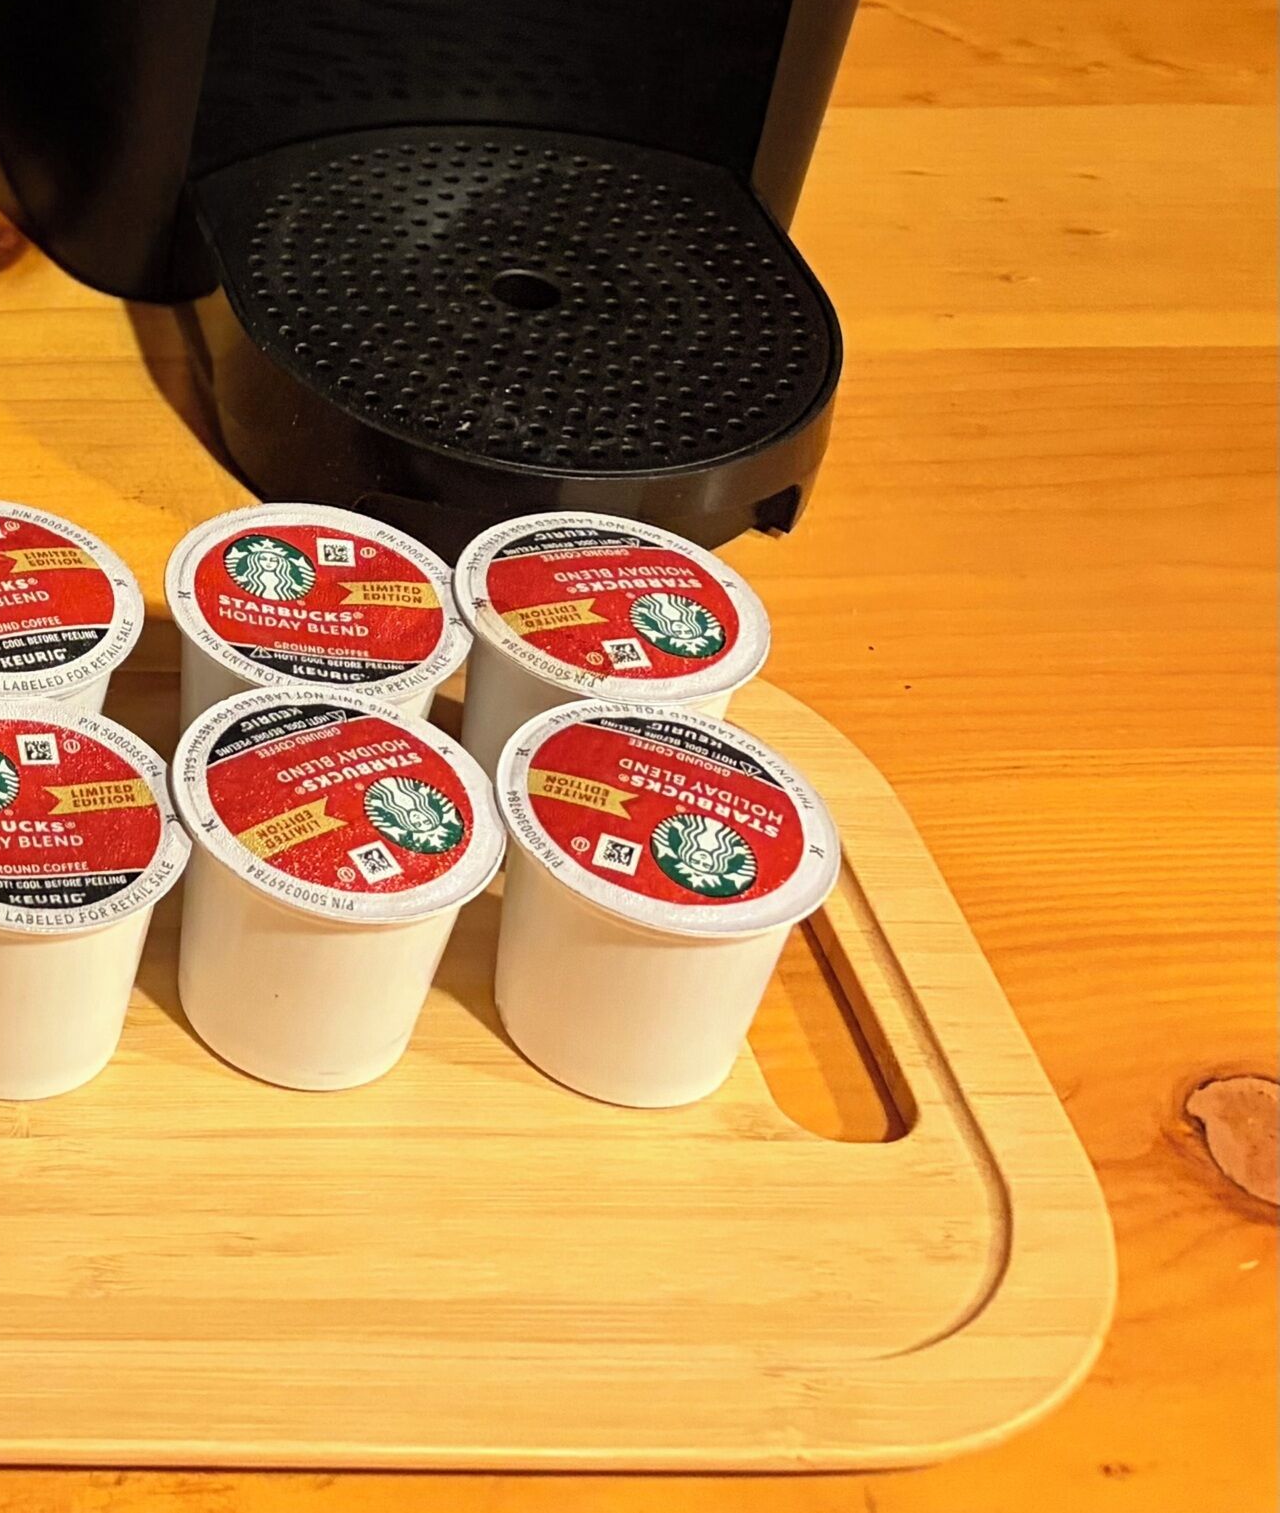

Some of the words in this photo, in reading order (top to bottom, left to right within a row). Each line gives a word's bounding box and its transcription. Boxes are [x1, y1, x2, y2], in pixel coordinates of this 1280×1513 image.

[24, 550, 78, 560] LIMITED
[29, 557, 82, 567] EDITION
[554, 571, 613, 581] BLEND
[617, 568, 695, 577] HOLIDAY
[363, 584, 421, 595] LIMITED
[363, 593, 423, 604] EDITION
[521, 604, 577, 620] EDITION
[526, 612, 580, 627] LIMITED
[21, 616, 62, 628] COFFEE
[219, 608, 300, 630] HOLIDAY
[308, 621, 369, 637] BLEND
[26, 633, 60, 645] BEFORE
[62, 630, 98, 640] PEELING
[1, 648, 67, 669] KEURIG
[3, 675, 64, 691] LABELED
[66, 665, 92, 682] FOR
[91, 643, 123, 670] RETAIL
[118, 618, 134, 649] SALE
[274, 642, 323, 656] GROUND
[197, 628, 220, 651] THIS
[222, 651, 249, 673] UNIT
[254, 668, 283, 685] NOT
[386, 673, 424, 694] RETAIL
[427, 654, 450, 676] SALE
[293, 666, 363, 680] KEURIG
[232, 692, 292, 712] LABELED
[299, 692, 323, 700] NOT
[209, 710, 228, 727] FOR
[241, 708, 303, 732] KEURIG
[369, 704, 400, 721] THIS
[294, 728, 341, 748] GROUND
[650, 722, 722, 748] KEURIG
[217, 737, 257, 757] PEELING
[256, 743, 291, 759] COFFEE
[339, 739, 411, 764] HOLIDAY
[628, 737, 674, 756] COFFEE
[737, 740, 765, 761] NOT
[184, 754, 198, 782] SALE
[278, 759, 334, 783] BLEND
[619, 758, 686, 786] BLEND
[677, 750, 731, 777] GROUND
[761, 755, 794, 783] UNIT
[71, 784, 133, 798] LIMITED
[543, 783, 606, 808] LIMITED
[545, 775, 610, 797] EDITION
[72, 794, 135, 808] EDITION
[692, 781, 784, 824] HOLIDAY
[792, 786, 814, 811] THIS
[256, 809, 314, 840] EDITION
[265, 818, 321, 850] LIMITED
[21, 835, 83, 848] BLEND
[43, 862, 89, 872] COFFEE
[45, 877, 82, 888] BEFORE
[85, 875, 127, 887] PEELING
[5, 911, 74, 926] LABELED
[78, 907, 108, 923] FOR
[111, 885, 154, 913] RETAIL
[152, 861, 174, 887] SALE
[9, 894, 83, 905] KEURIG
